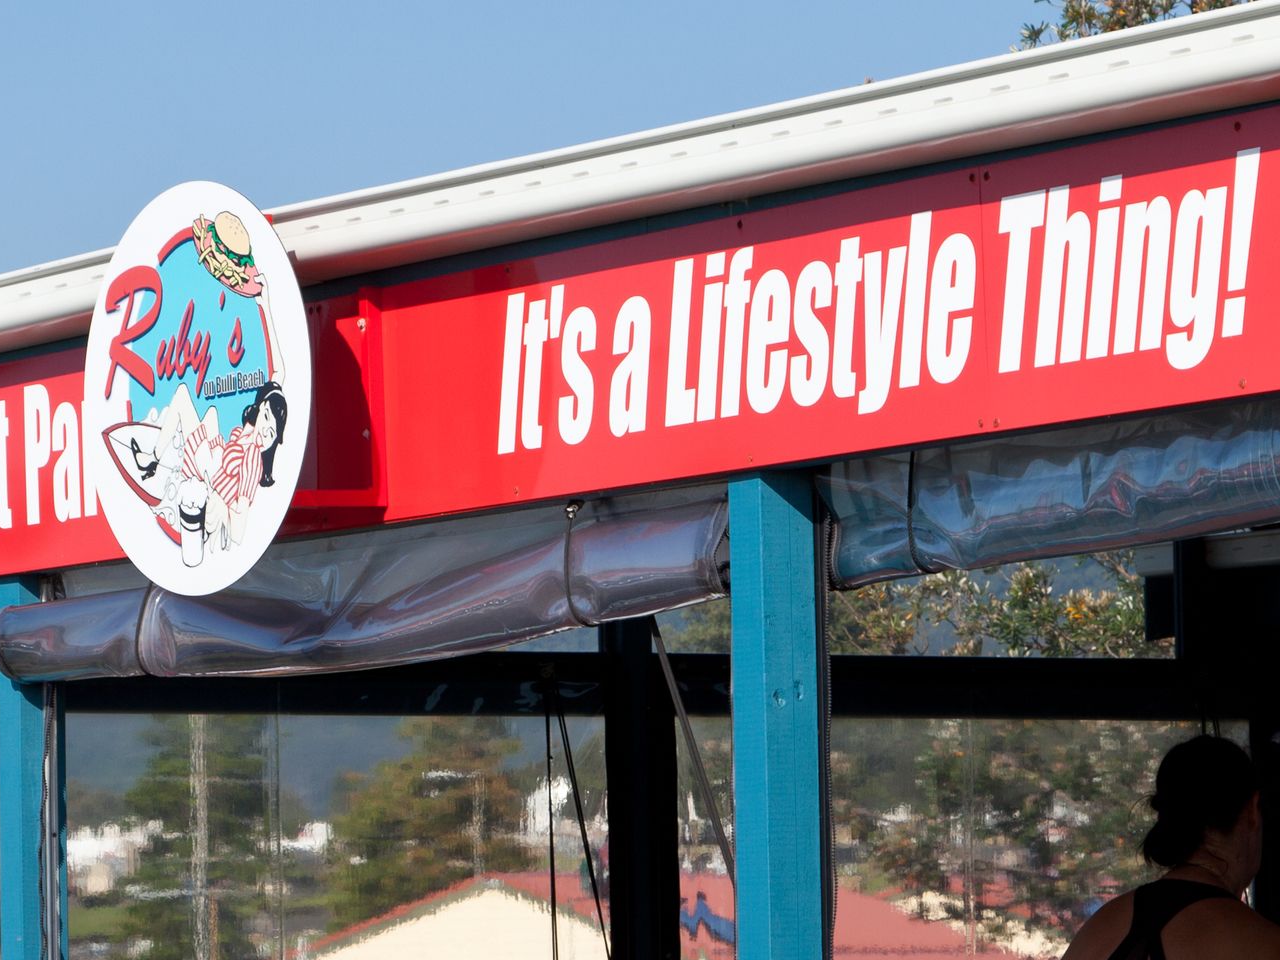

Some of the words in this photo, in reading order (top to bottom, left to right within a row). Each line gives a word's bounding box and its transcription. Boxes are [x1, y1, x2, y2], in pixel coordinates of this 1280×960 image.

[105, 265, 246, 399] Ruby's
[498, 284, 596, 455] It's
[610, 295, 652, 437] a
[665, 210, 977, 429] Lifestyle
[998, 147, 1261, 372] Thing!
[216, 374, 236, 396] Bulli
[237, 369, 265, 391] Beach
